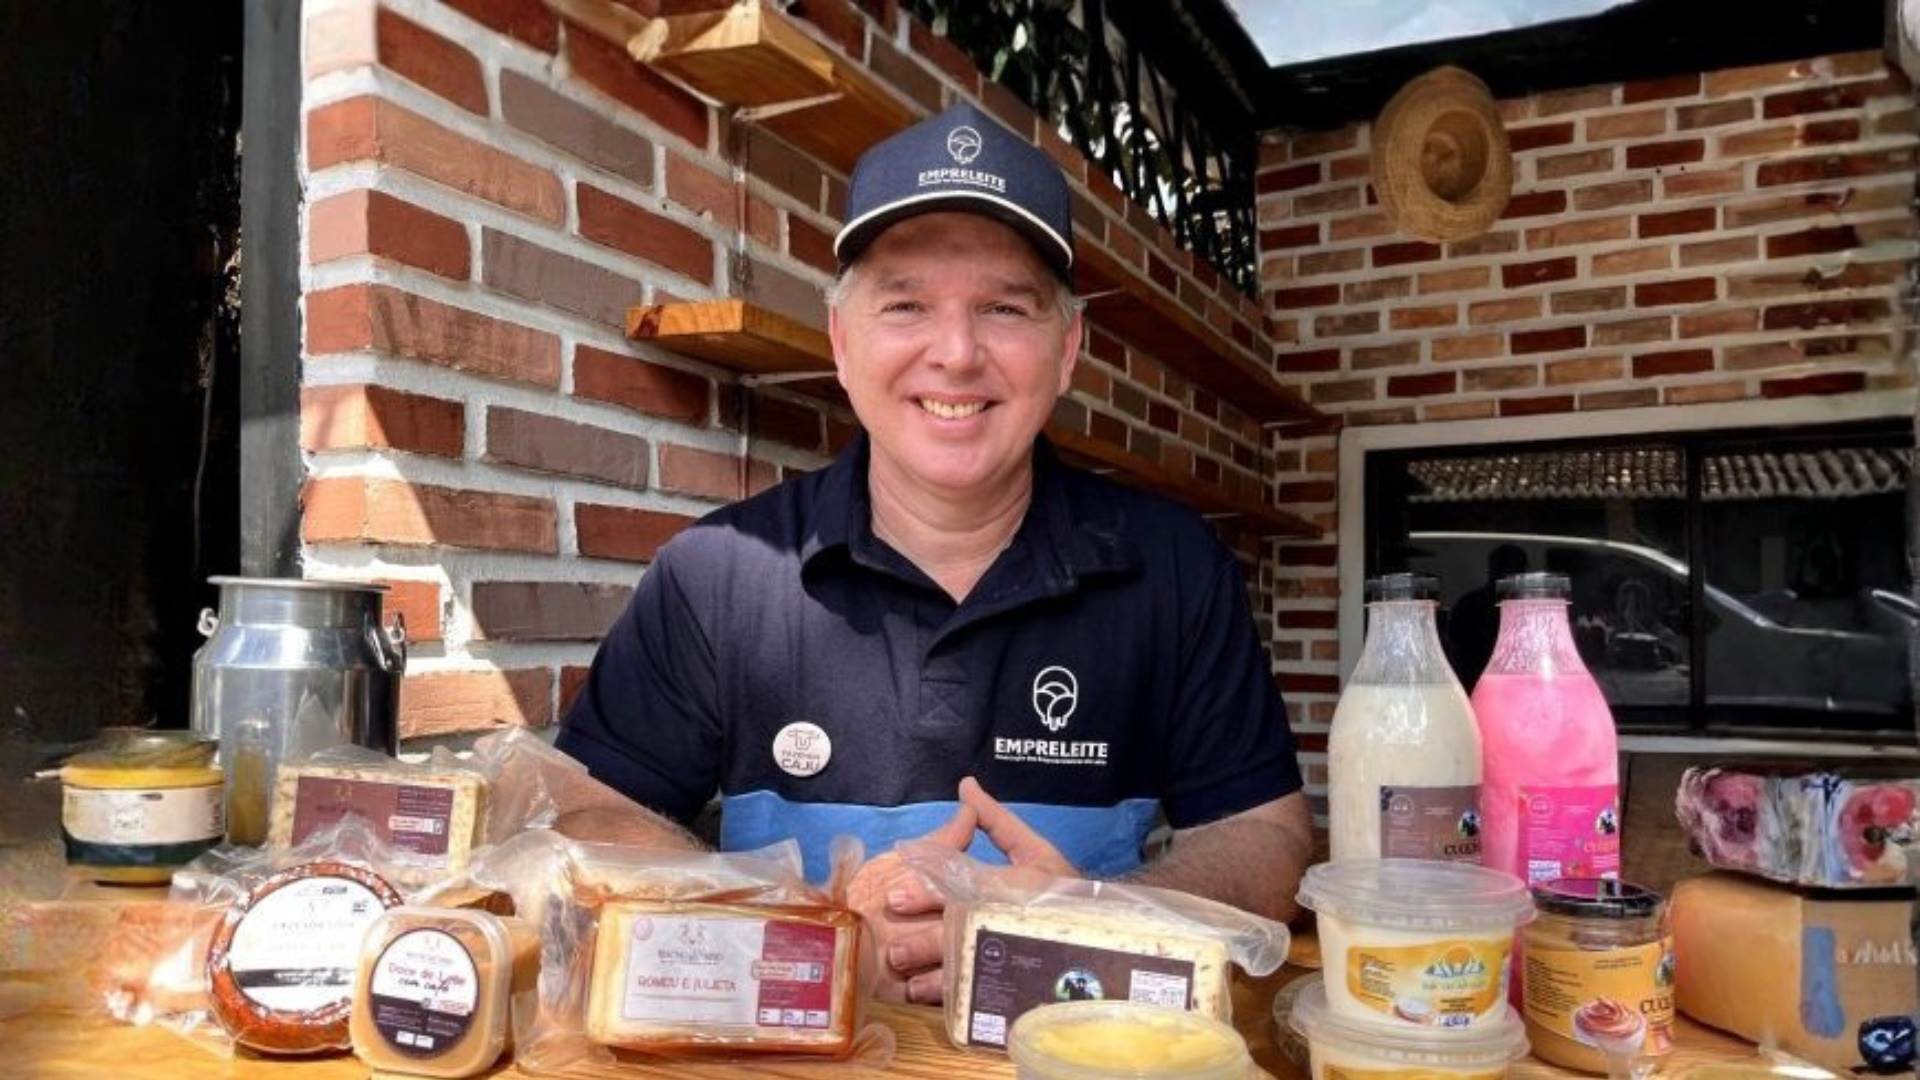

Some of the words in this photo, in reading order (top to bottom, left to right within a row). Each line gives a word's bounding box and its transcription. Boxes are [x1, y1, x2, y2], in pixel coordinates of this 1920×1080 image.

[918, 168, 1006, 188] EMPRELEITE
[994, 737, 1108, 758] EMPRELEITE
[388, 962, 417, 974] Doce
[420, 968, 434, 980] de
[439, 971, 466, 986] Leite
[637, 975, 680, 989] ROMEU
[682, 976, 691, 990] E
[692, 977, 737, 992] JULIETA
